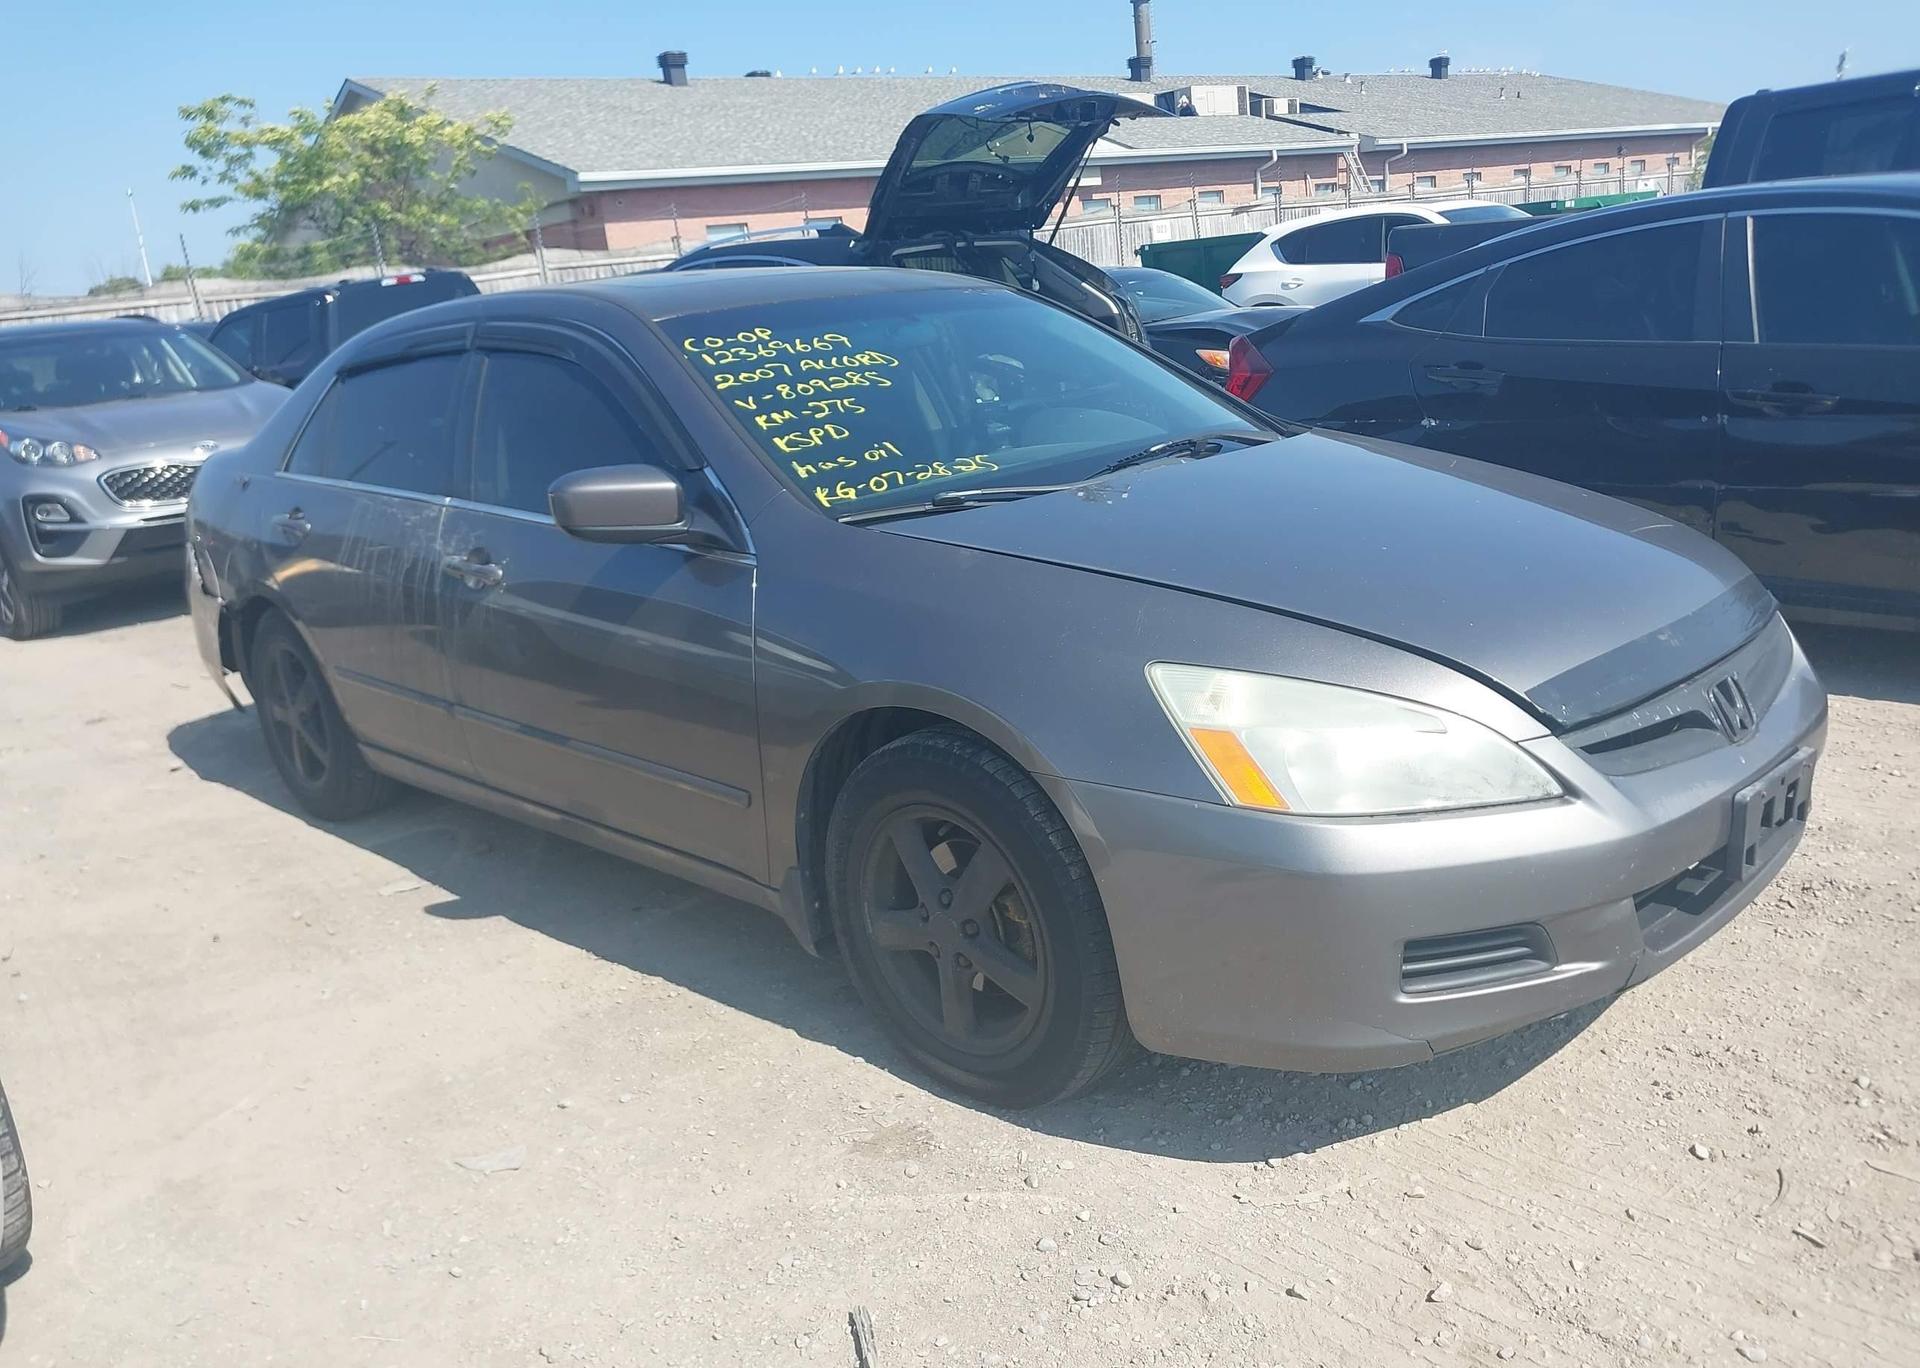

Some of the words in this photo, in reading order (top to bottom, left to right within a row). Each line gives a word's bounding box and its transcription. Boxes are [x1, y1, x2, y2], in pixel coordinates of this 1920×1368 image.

[684, 327, 772, 351] CO-OP
[701, 333, 852, 366] 12369669
[714, 363, 793, 390] 2007
[800, 350, 899, 372] ACCORD
[772, 424, 850, 453] KSPD
[791, 455, 857, 479] has
[864, 441, 904, 461] oil
